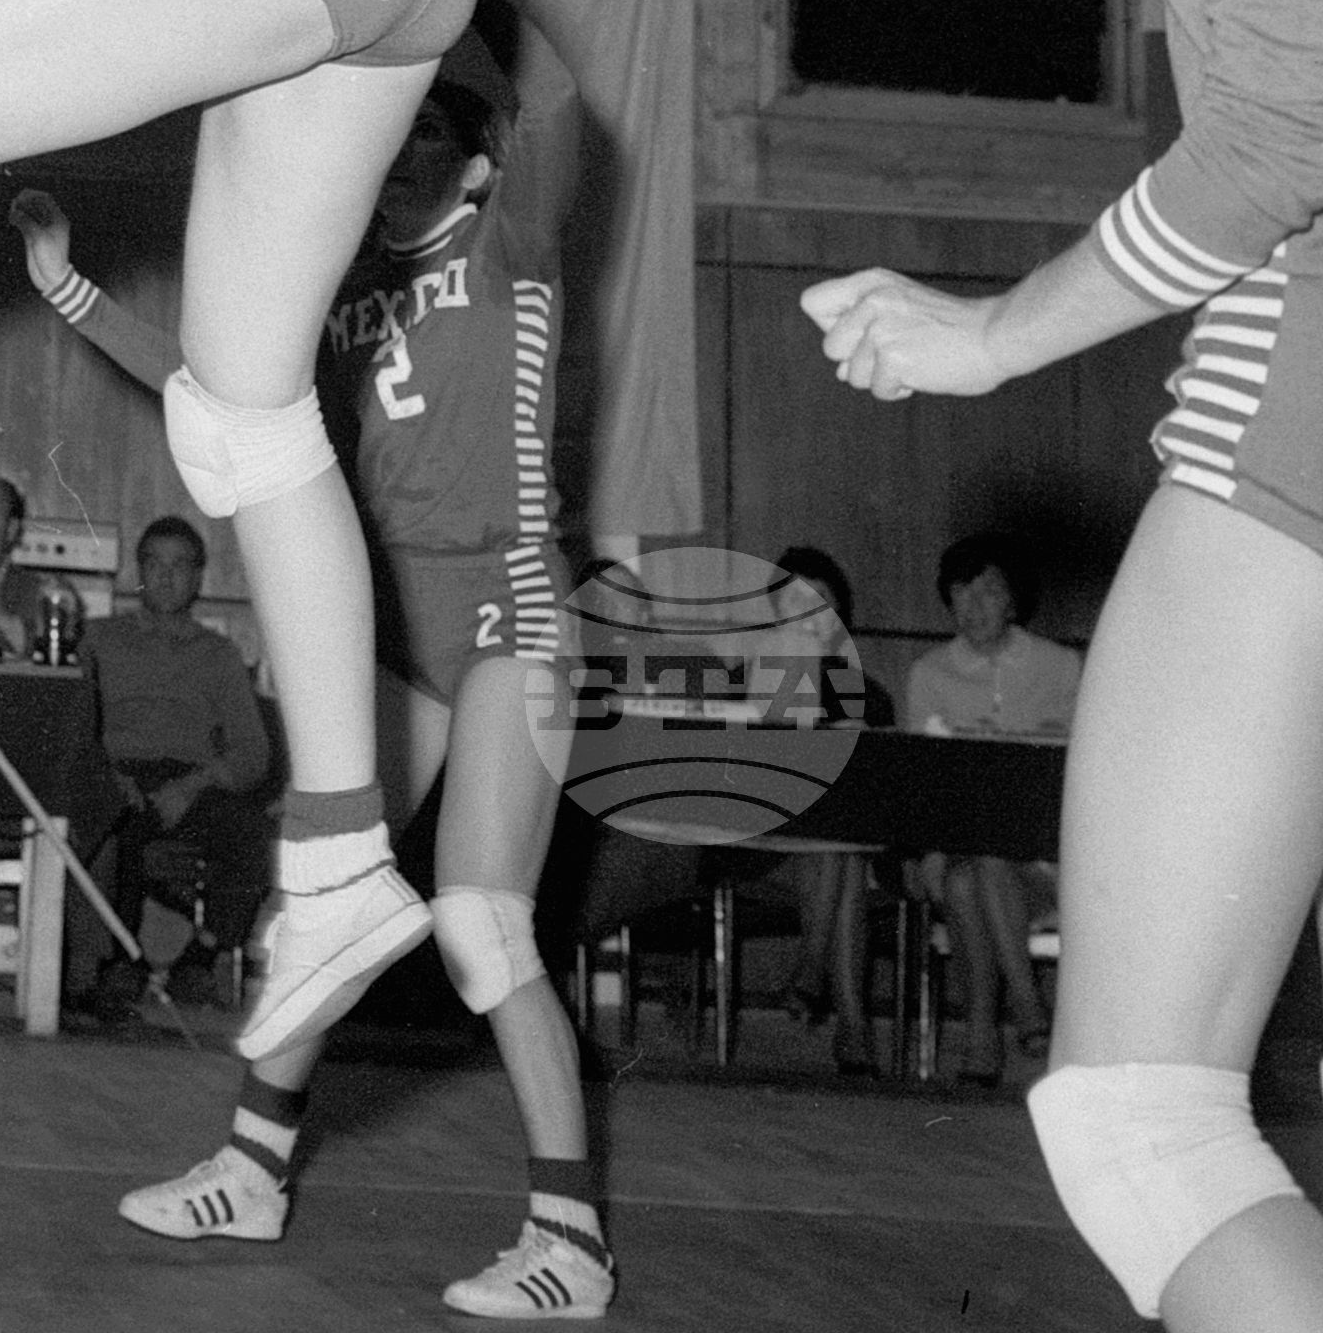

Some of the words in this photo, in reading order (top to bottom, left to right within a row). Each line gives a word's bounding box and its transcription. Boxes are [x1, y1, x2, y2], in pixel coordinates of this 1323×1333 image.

[325, 256, 472, 356] MEXCO
[371, 327, 427, 422] 2
[475, 602, 503, 649] 2
